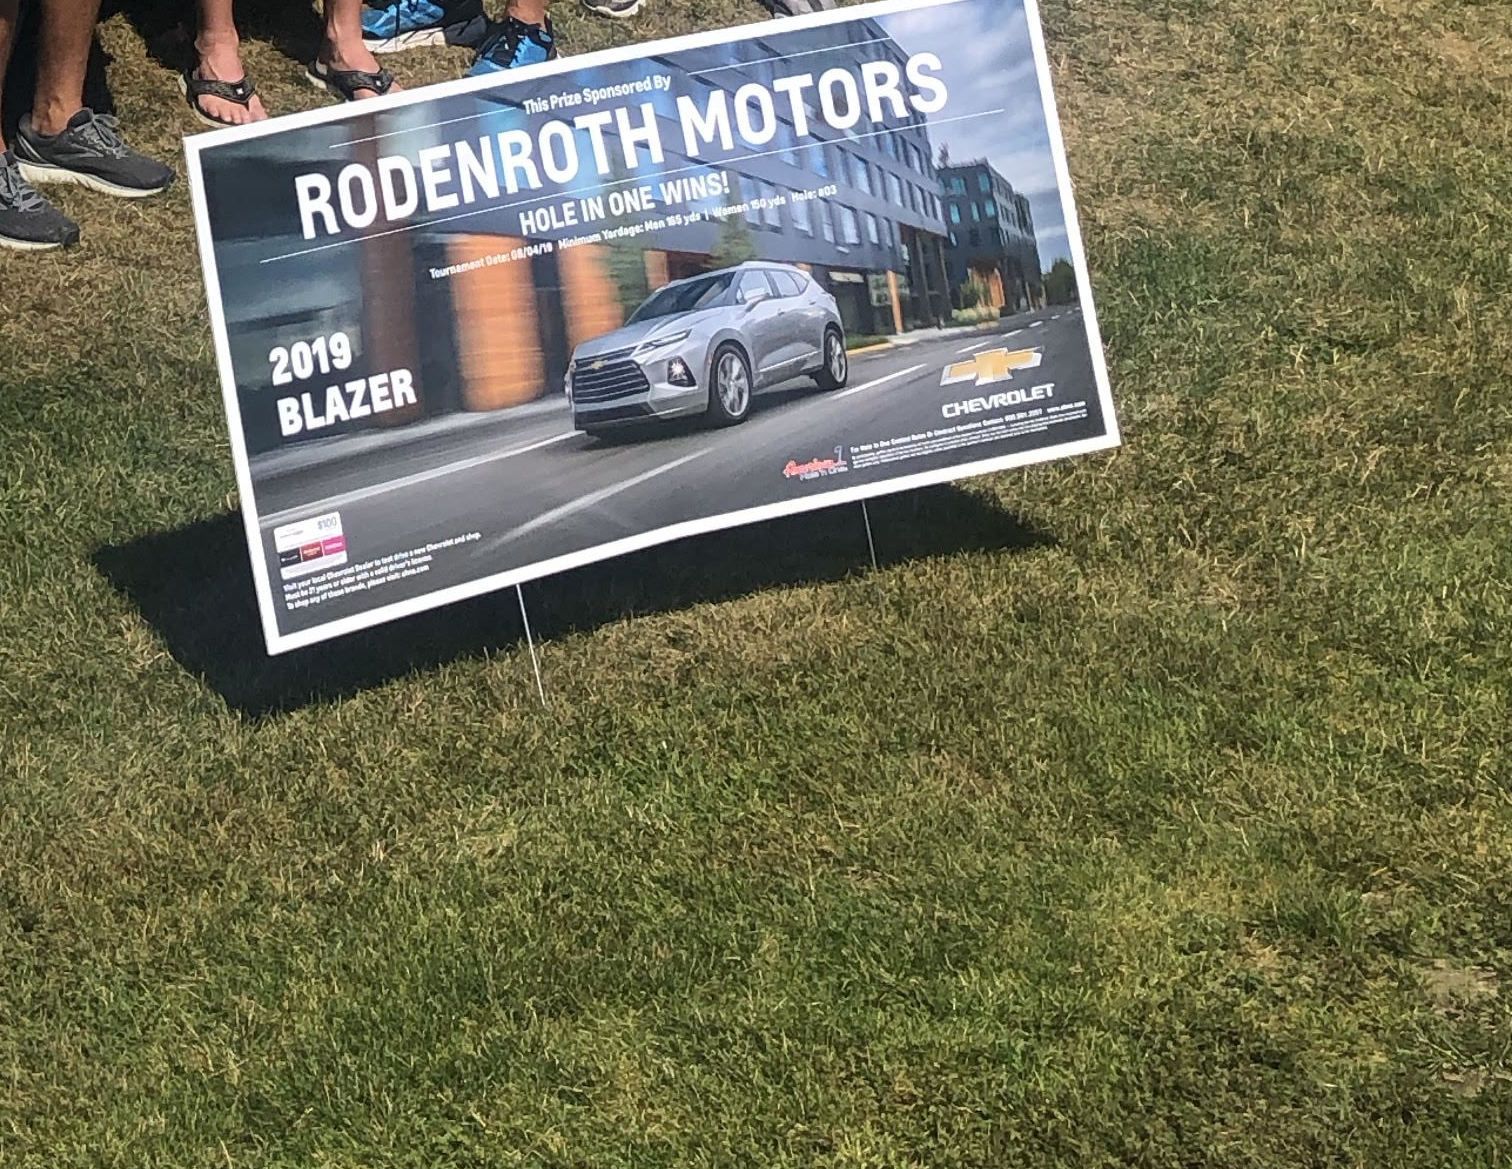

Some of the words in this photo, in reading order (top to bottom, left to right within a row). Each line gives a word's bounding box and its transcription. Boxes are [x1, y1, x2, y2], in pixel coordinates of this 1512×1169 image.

[522, 97, 549, 115] This
[550, 91, 582, 109] Prize
[582, 75, 652, 105] Sponsored
[653, 74, 671, 91] By
[296, 107, 666, 240] RODENROTH
[678, 52, 949, 158] MOTORS
[519, 201, 578, 235] HOLE
[581, 197, 606, 222] IN
[608, 185, 656, 216] ONE
[659, 170, 731, 206] WINS!
[429, 259, 485, 280] Tournament
[485, 253, 511, 269] Date:
[557, 234, 602, 250] Minimum
[602, 224, 644, 243] Yardage:
[683, 211, 701, 226] yds
[712, 203, 750, 218] Women
[768, 195, 786, 210] yds
[269, 332, 352, 386] 2019
[277, 368, 417, 437] BLAZER
[942, 383, 1055, 419] CHEVROLET
